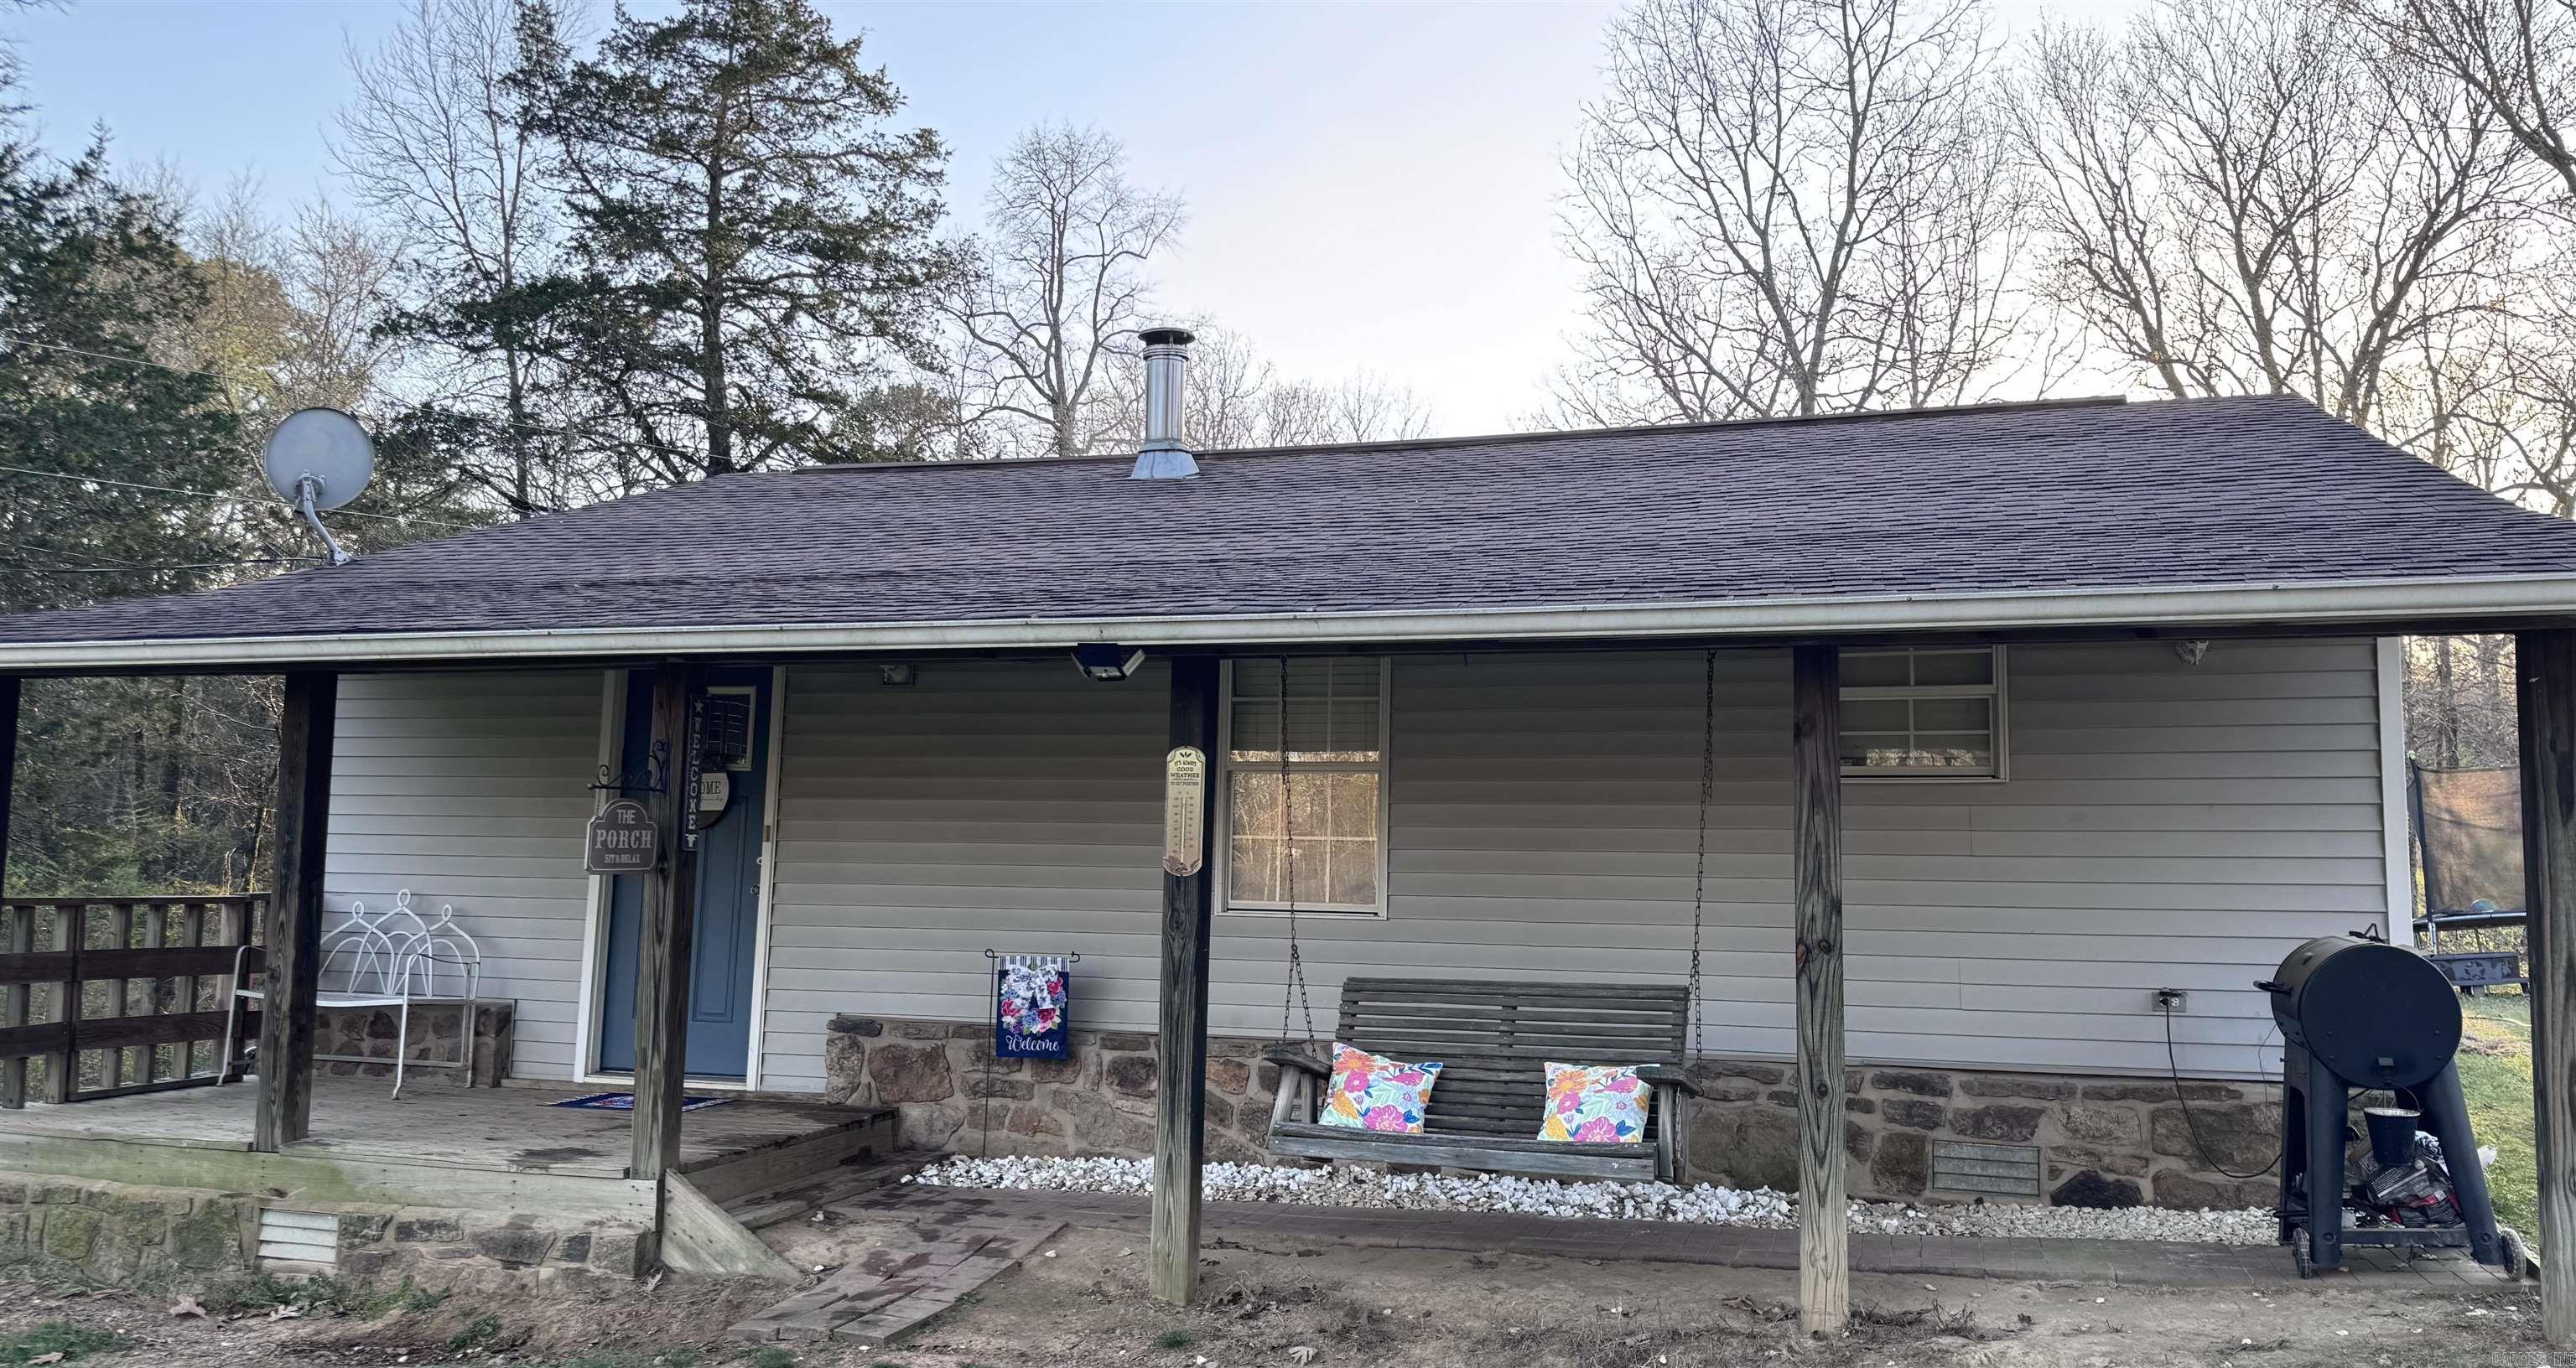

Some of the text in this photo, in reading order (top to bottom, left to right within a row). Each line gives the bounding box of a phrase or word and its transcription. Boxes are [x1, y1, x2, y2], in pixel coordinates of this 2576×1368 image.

[688, 717, 702, 830] WELCOME
[616, 810, 636, 824] THE
[595, 829, 652, 849] PORCH
[604, 853, 615, 863] SIT
[621, 853, 641, 863] RELAX
[1005, 1034, 1060, 1052] Welcome
